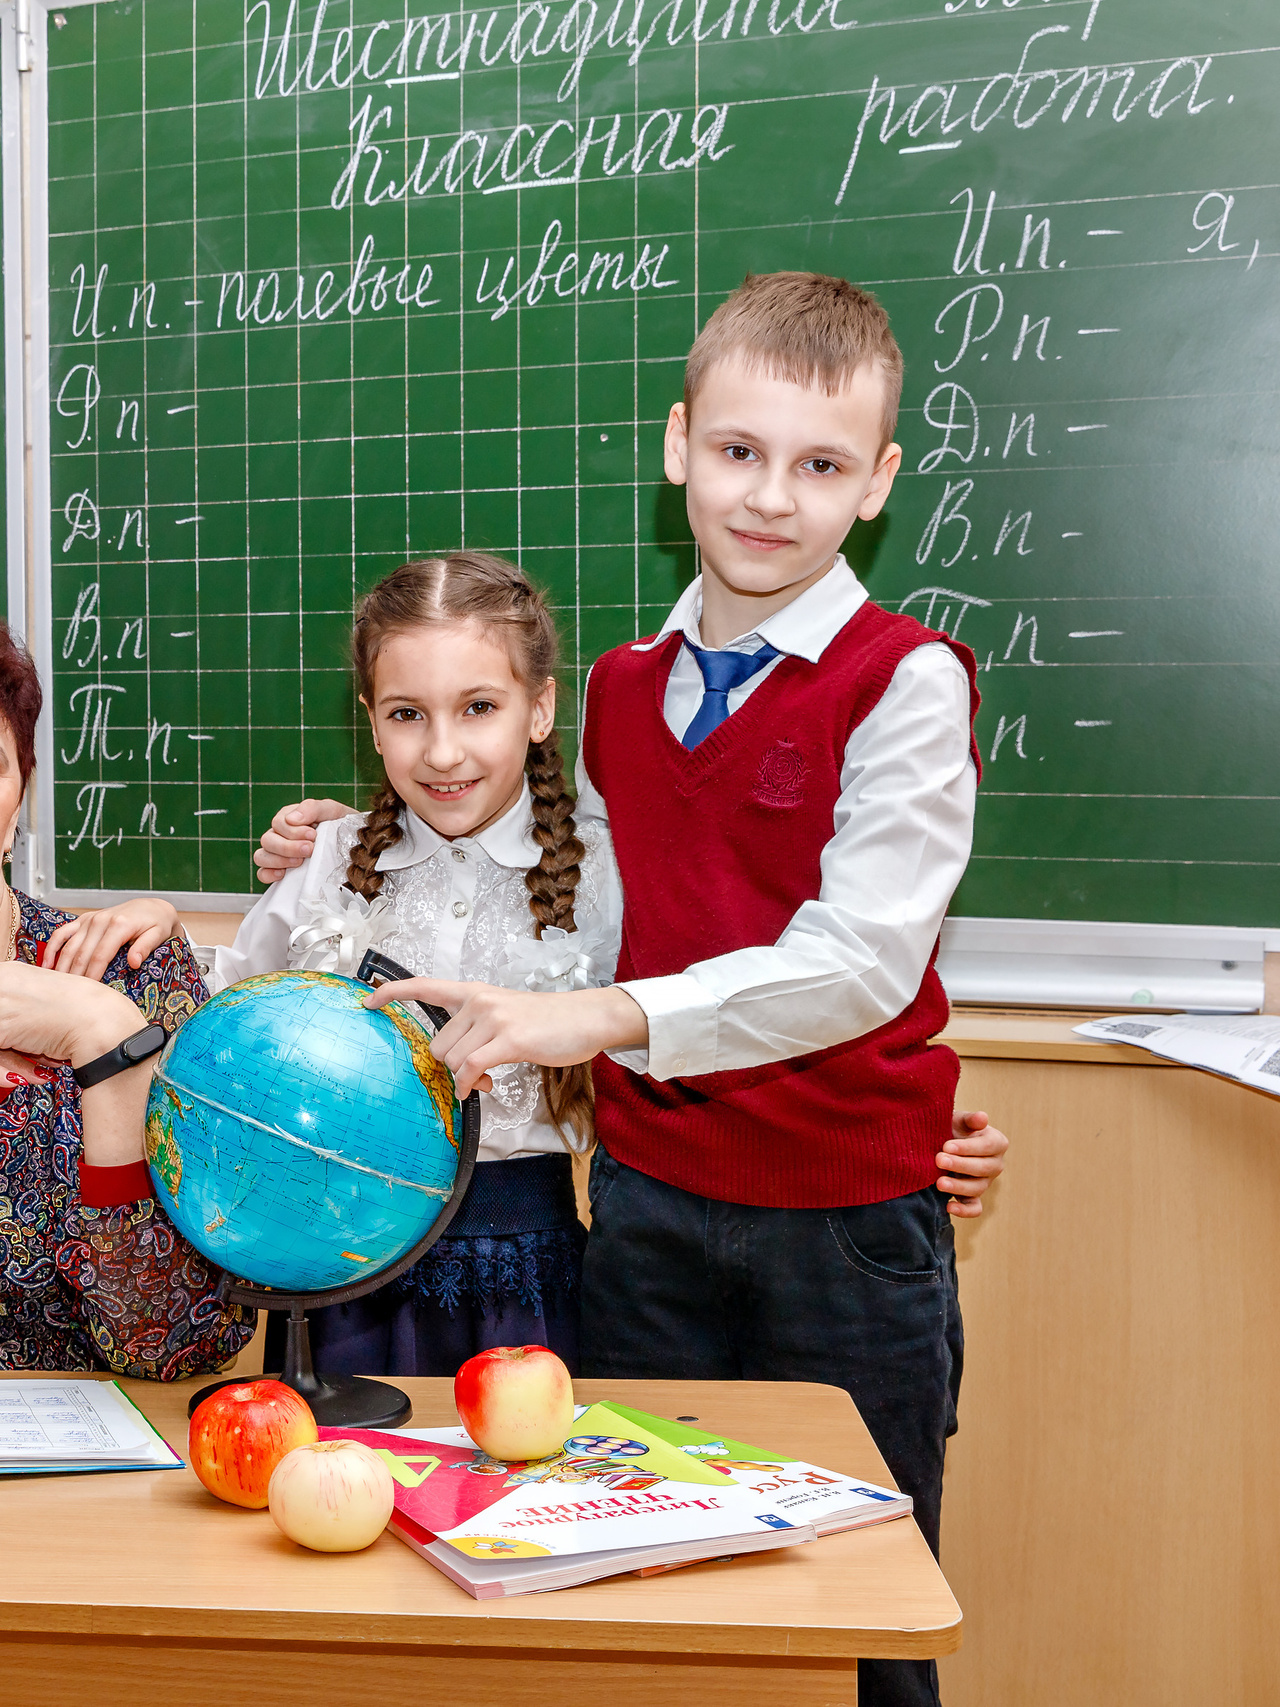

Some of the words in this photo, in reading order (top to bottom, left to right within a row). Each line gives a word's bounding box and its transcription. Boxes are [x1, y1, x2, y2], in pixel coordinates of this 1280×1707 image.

[331, 95, 734, 209] Классная
[835, 26, 1235, 205] работа.
[216, 235, 440, 328] полевые
[477, 220, 679, 320] цветы
[499, 1497, 726, 1529] Литературное
[515, 1491, 678, 1518] ЧТЕНИЕ
